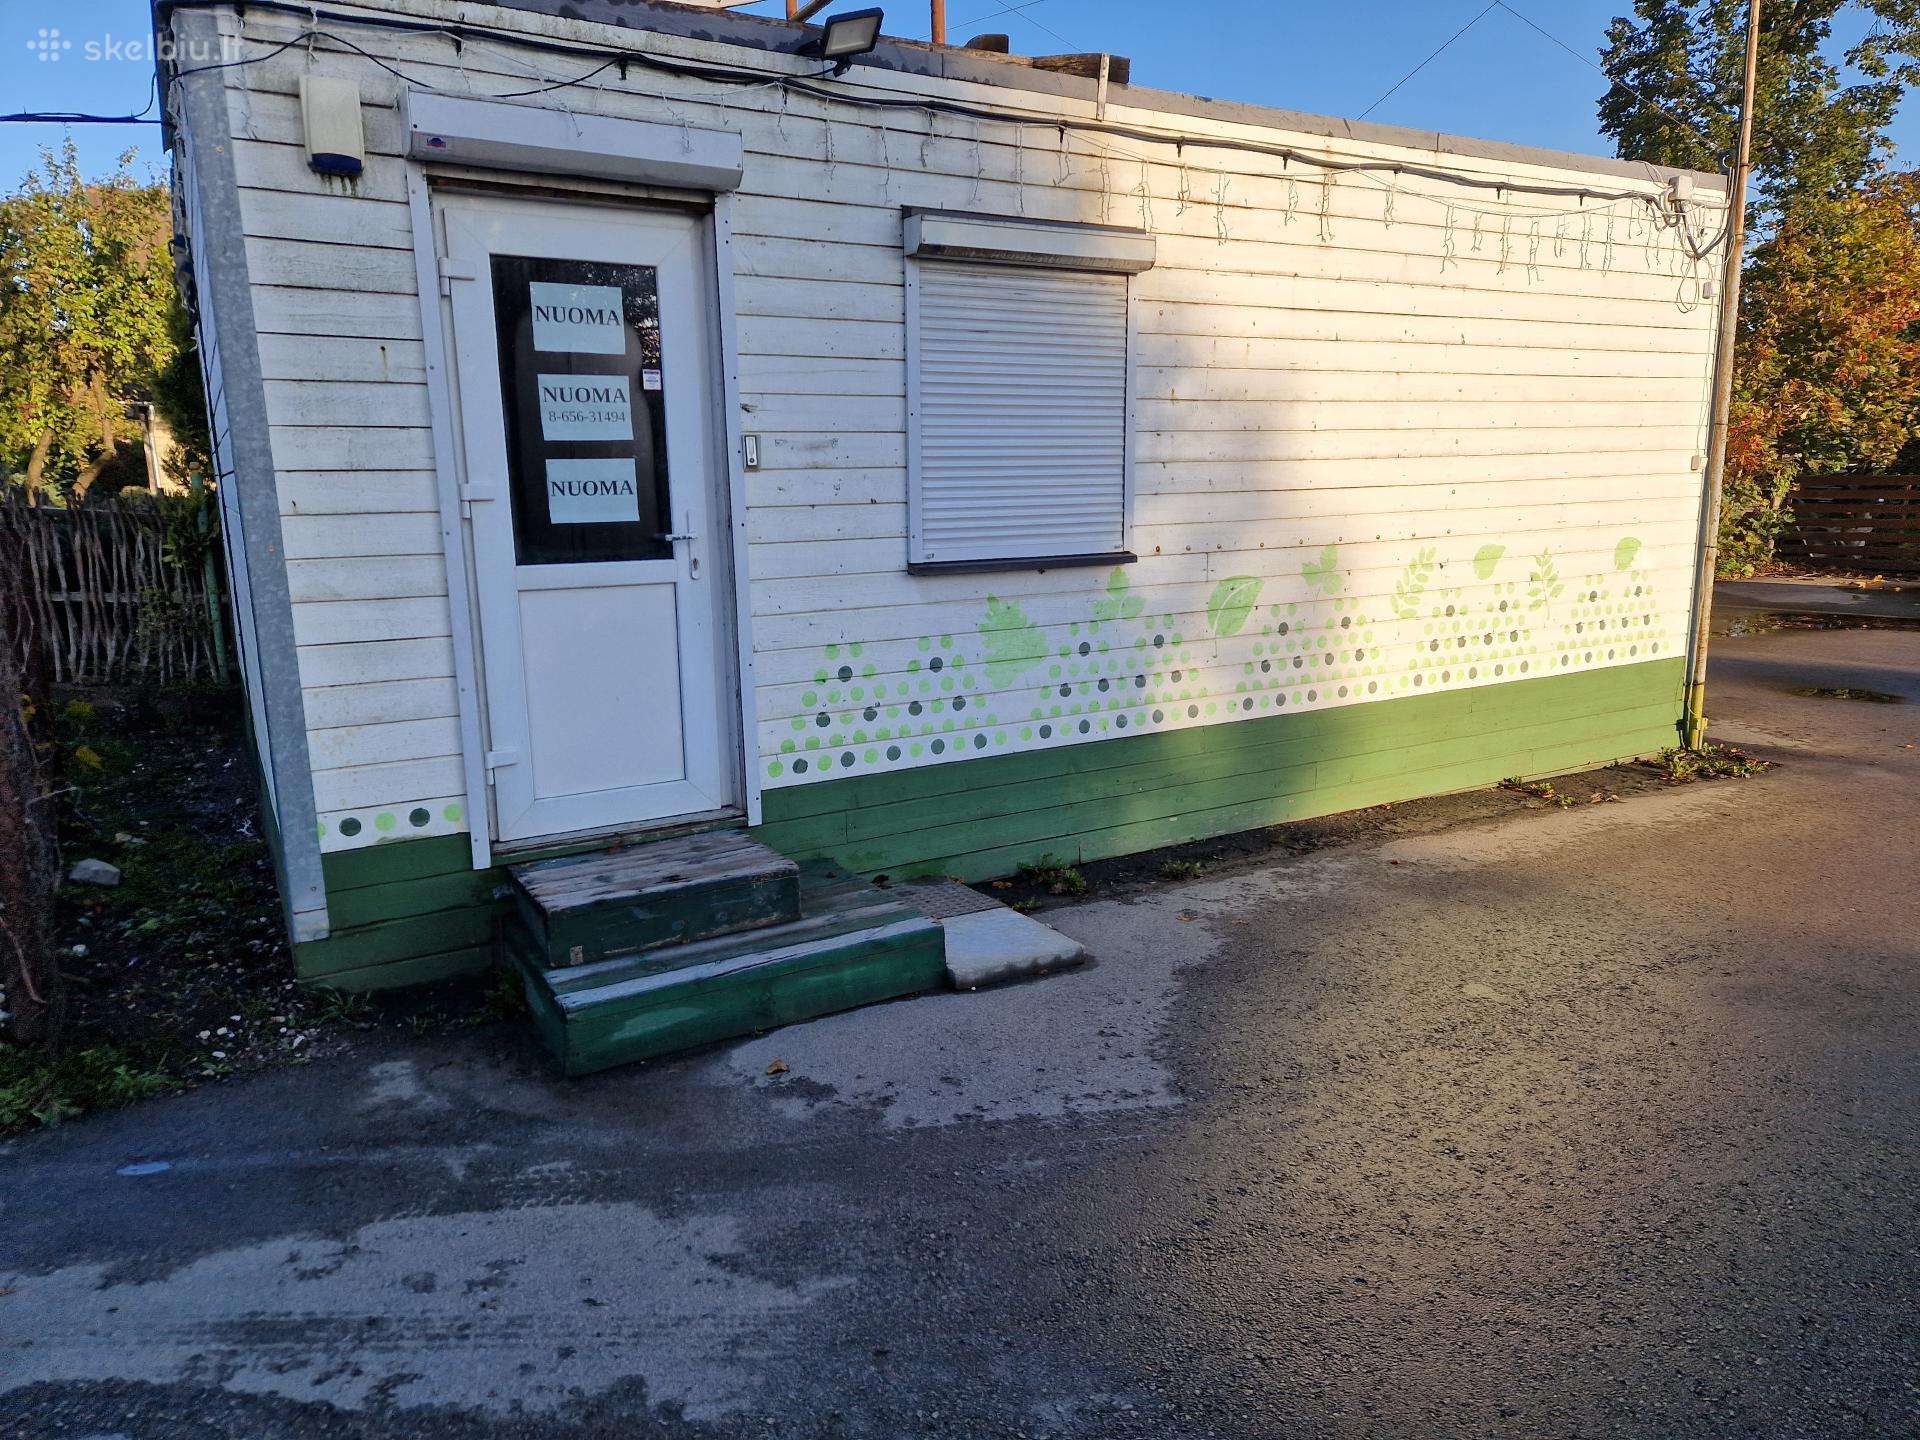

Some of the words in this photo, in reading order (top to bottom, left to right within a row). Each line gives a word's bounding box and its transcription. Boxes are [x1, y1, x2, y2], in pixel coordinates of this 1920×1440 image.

[535, 305, 621, 326] NUOMA
[542, 386, 627, 403] NUOMA
[548, 410, 626, 423] 8-656-31494
[550, 480, 634, 497] NUOMA
